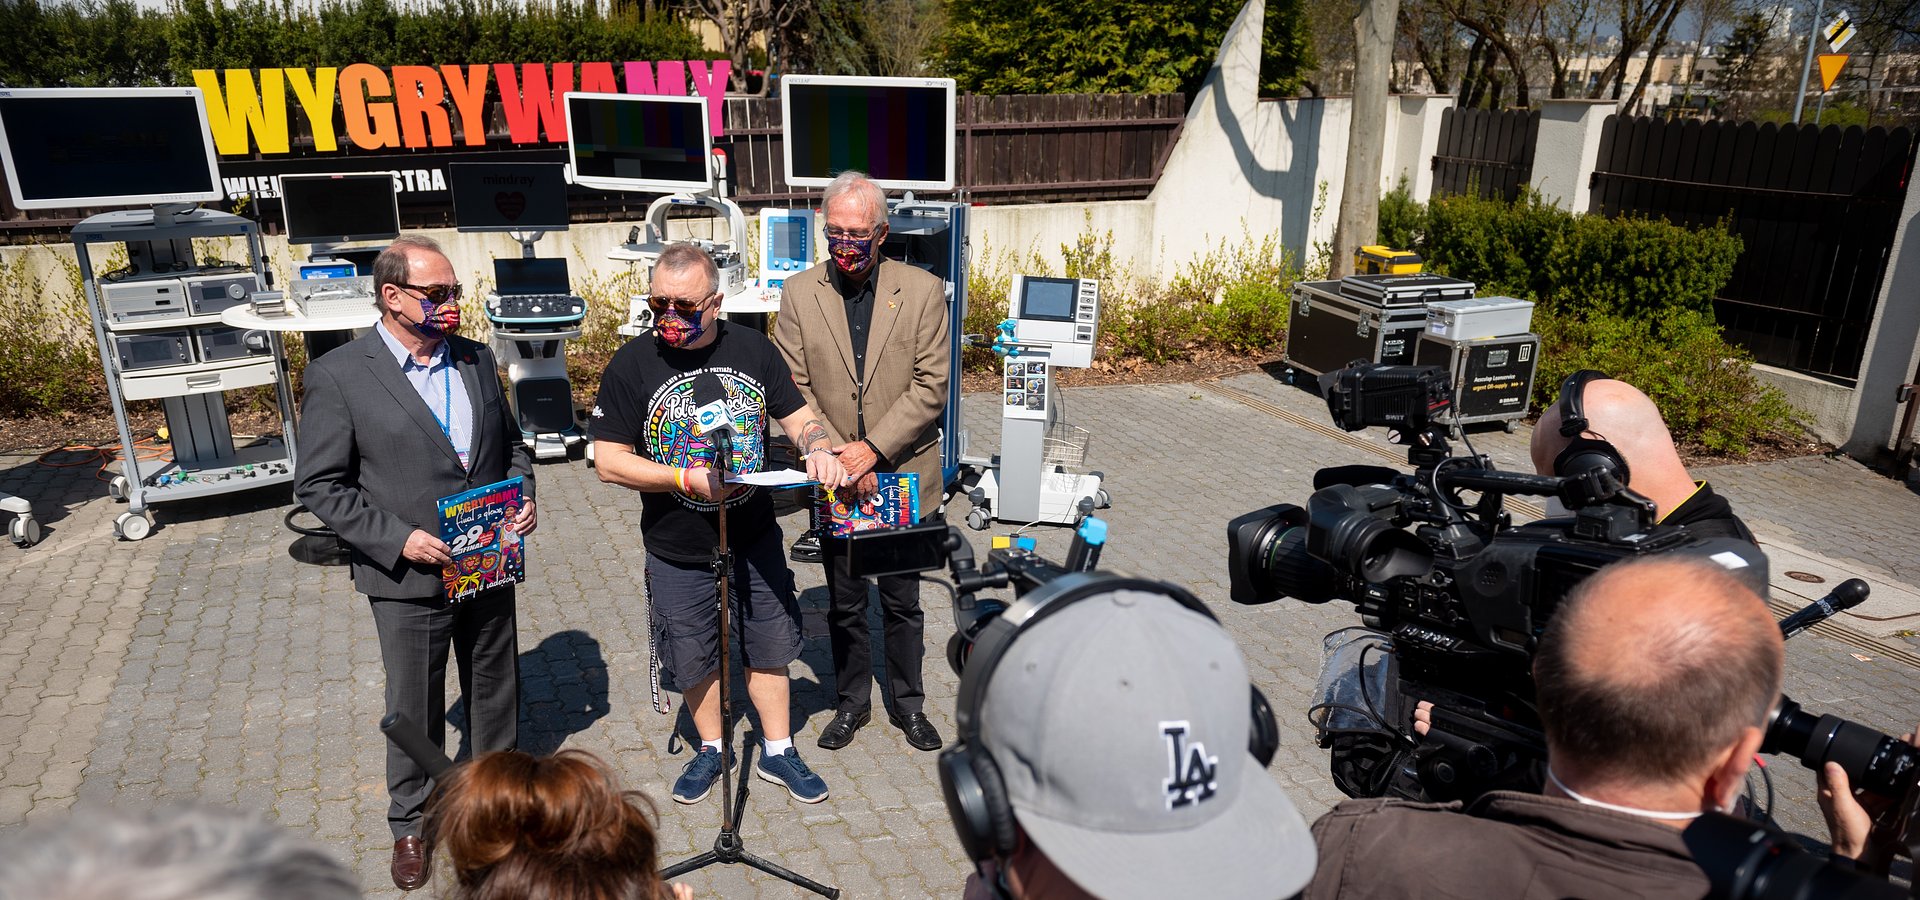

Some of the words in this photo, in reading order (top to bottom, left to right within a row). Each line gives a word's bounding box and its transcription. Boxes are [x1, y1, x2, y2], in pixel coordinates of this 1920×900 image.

[222, 175, 281, 200] WIEL
[482, 173, 535, 188] mindray
[444, 488, 519, 519] WYGRYWAMY
[898, 477, 910, 525] WYGRYWA
[452, 525, 484, 557] 29
[1159, 720, 1219, 811] LA
